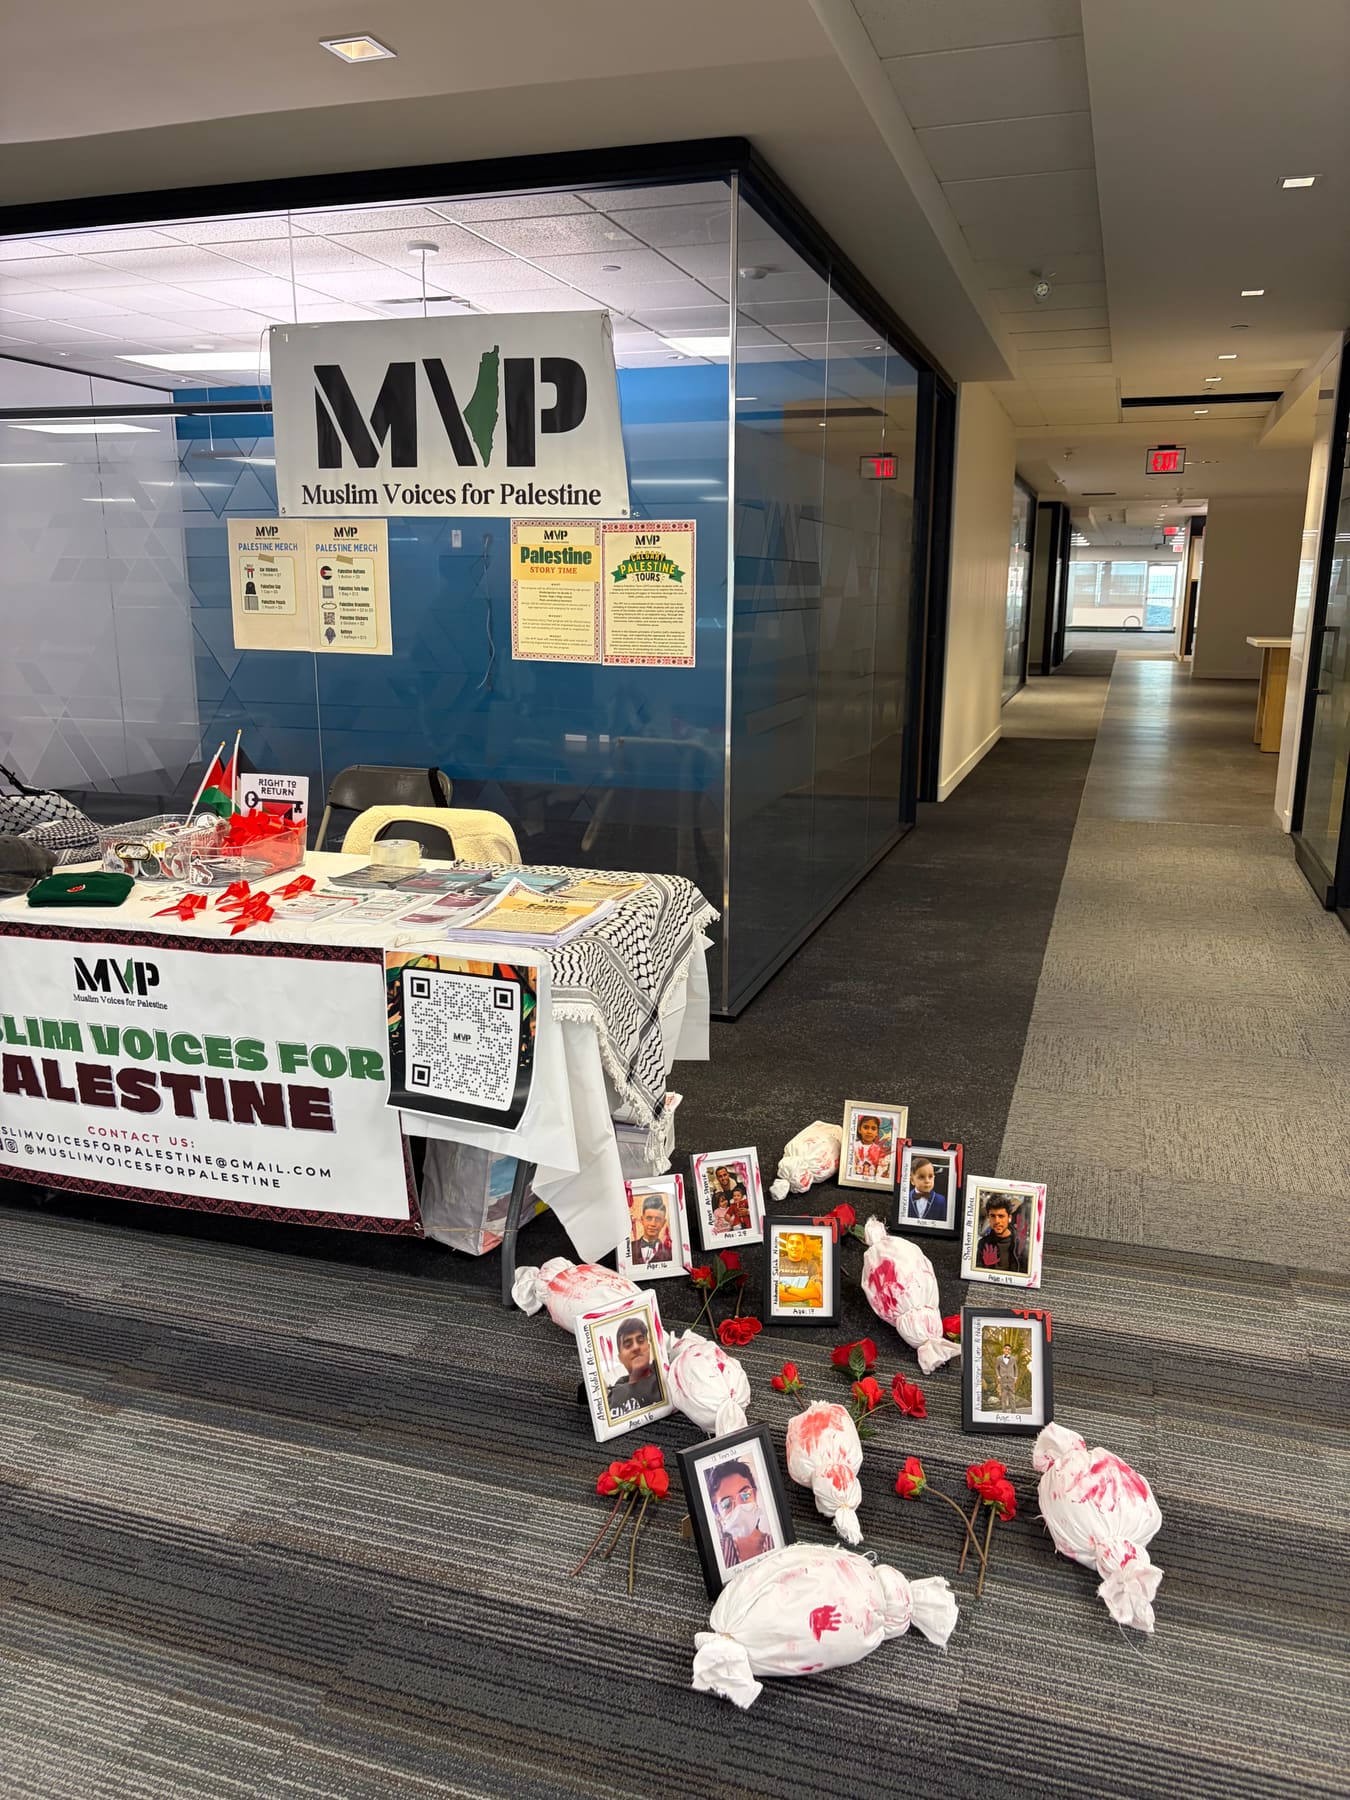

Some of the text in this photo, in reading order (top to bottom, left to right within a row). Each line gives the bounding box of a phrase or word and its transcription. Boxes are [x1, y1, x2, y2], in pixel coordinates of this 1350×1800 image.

[313, 346, 588, 469] MVP
[1153, 451, 1179, 472] EXIT
[302, 481, 602, 507] Muslim Voices for Palestine
[255, 526, 279, 537] MVP
[333, 526, 358, 538] MVP
[544, 530, 568, 541] MVP
[635, 534, 660, 546] MVP
[238, 542, 299, 552] PALESTINE MERCH
[315, 543, 378, 552] PALESTINE MERCH
[520, 546, 592, 566] Palestine
[529, 566, 578, 575] STORY TIME
[619, 560, 675, 576] PALESTINE
[635, 572, 660, 583] TOURS
[258, 778, 297, 789] RIGHT TO
[260, 786, 295, 797] RETURN
[73, 956, 160, 996] MVP
[73, 993, 169, 1011] Muslim Voices for Palestine
[453, 1032, 472, 1042] MVP
[87, 1022, 269, 1073] VOICES
[275, 1040, 386, 1082] FOR
[87, 1125, 197, 1149] CONTACT US:
[24, 1143, 282, 1190] @MUSLIMVOICESFORPALESTINE
